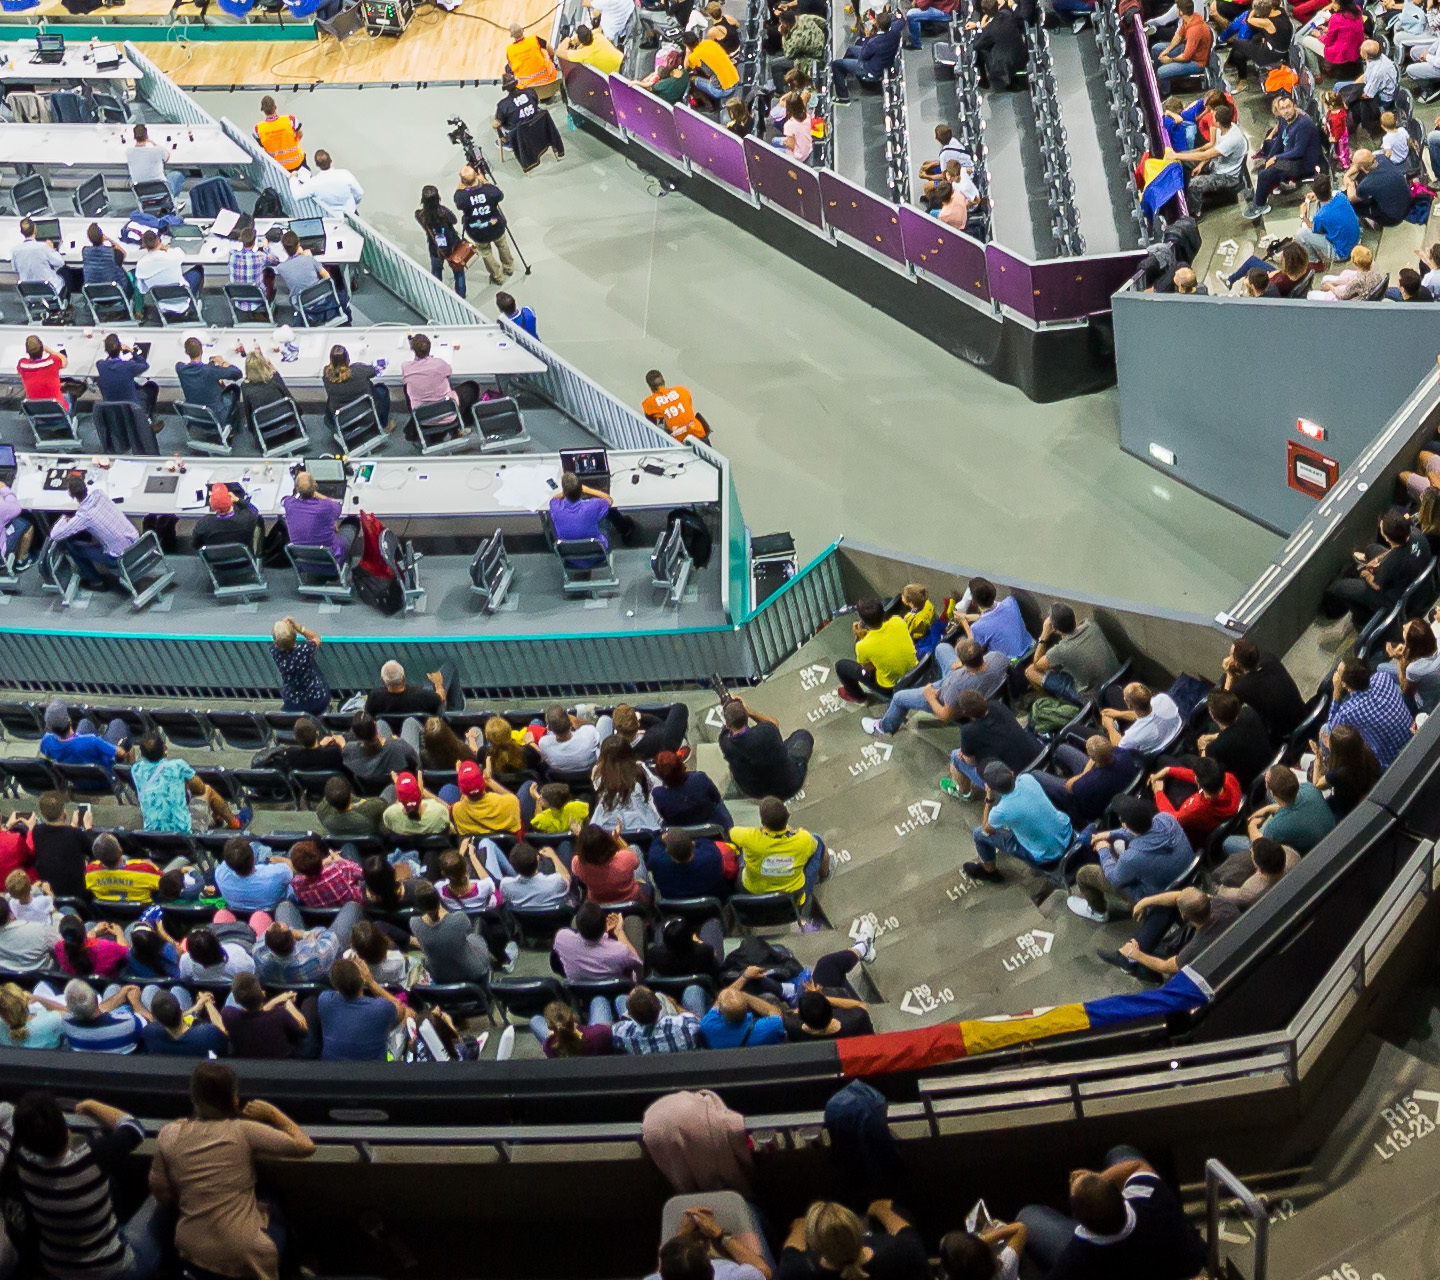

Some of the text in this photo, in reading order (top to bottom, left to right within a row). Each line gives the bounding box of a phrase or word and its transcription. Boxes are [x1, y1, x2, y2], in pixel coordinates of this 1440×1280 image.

[470, 193, 486, 205] HB
[472, 205, 491, 216] 402
[655, 390, 680, 406] RHB
[664, 402, 686, 419] 191
[907, 802, 923, 816] R7
[895, 809, 932, 836] L11-13
[1017, 933, 1034, 950] R9
[1003, 944, 1044, 971] L11-18
[913, 985, 930, 1000] R9
[919, 988, 955, 1013] L2-10
[1381, 1095, 1420, 1130] R15
[1375, 1114, 1436, 1160] L13-23
